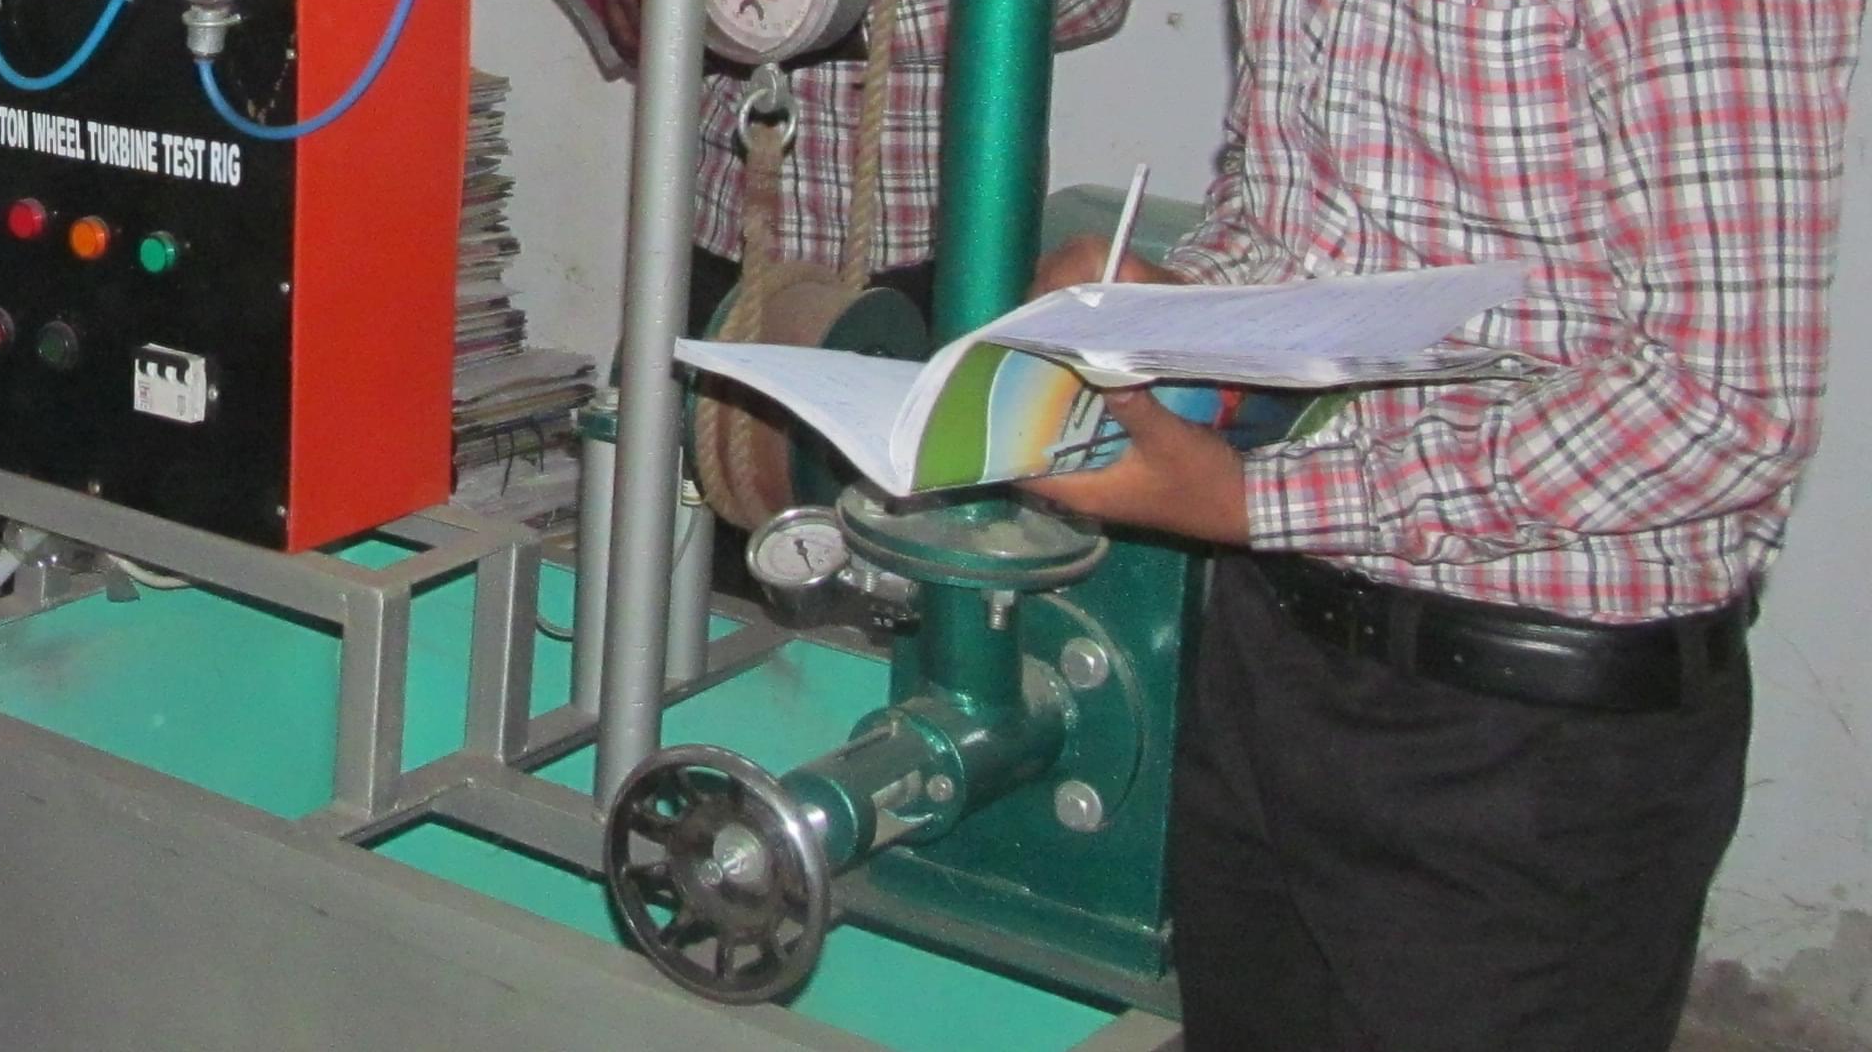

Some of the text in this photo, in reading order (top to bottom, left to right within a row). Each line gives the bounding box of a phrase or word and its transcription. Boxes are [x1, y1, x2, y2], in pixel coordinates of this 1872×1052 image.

[32, 112, 85, 160] WHEEL
[87, 121, 158, 173] TURBINE
[162, 134, 206, 180] TEST
[210, 141, 241, 186] RIG
